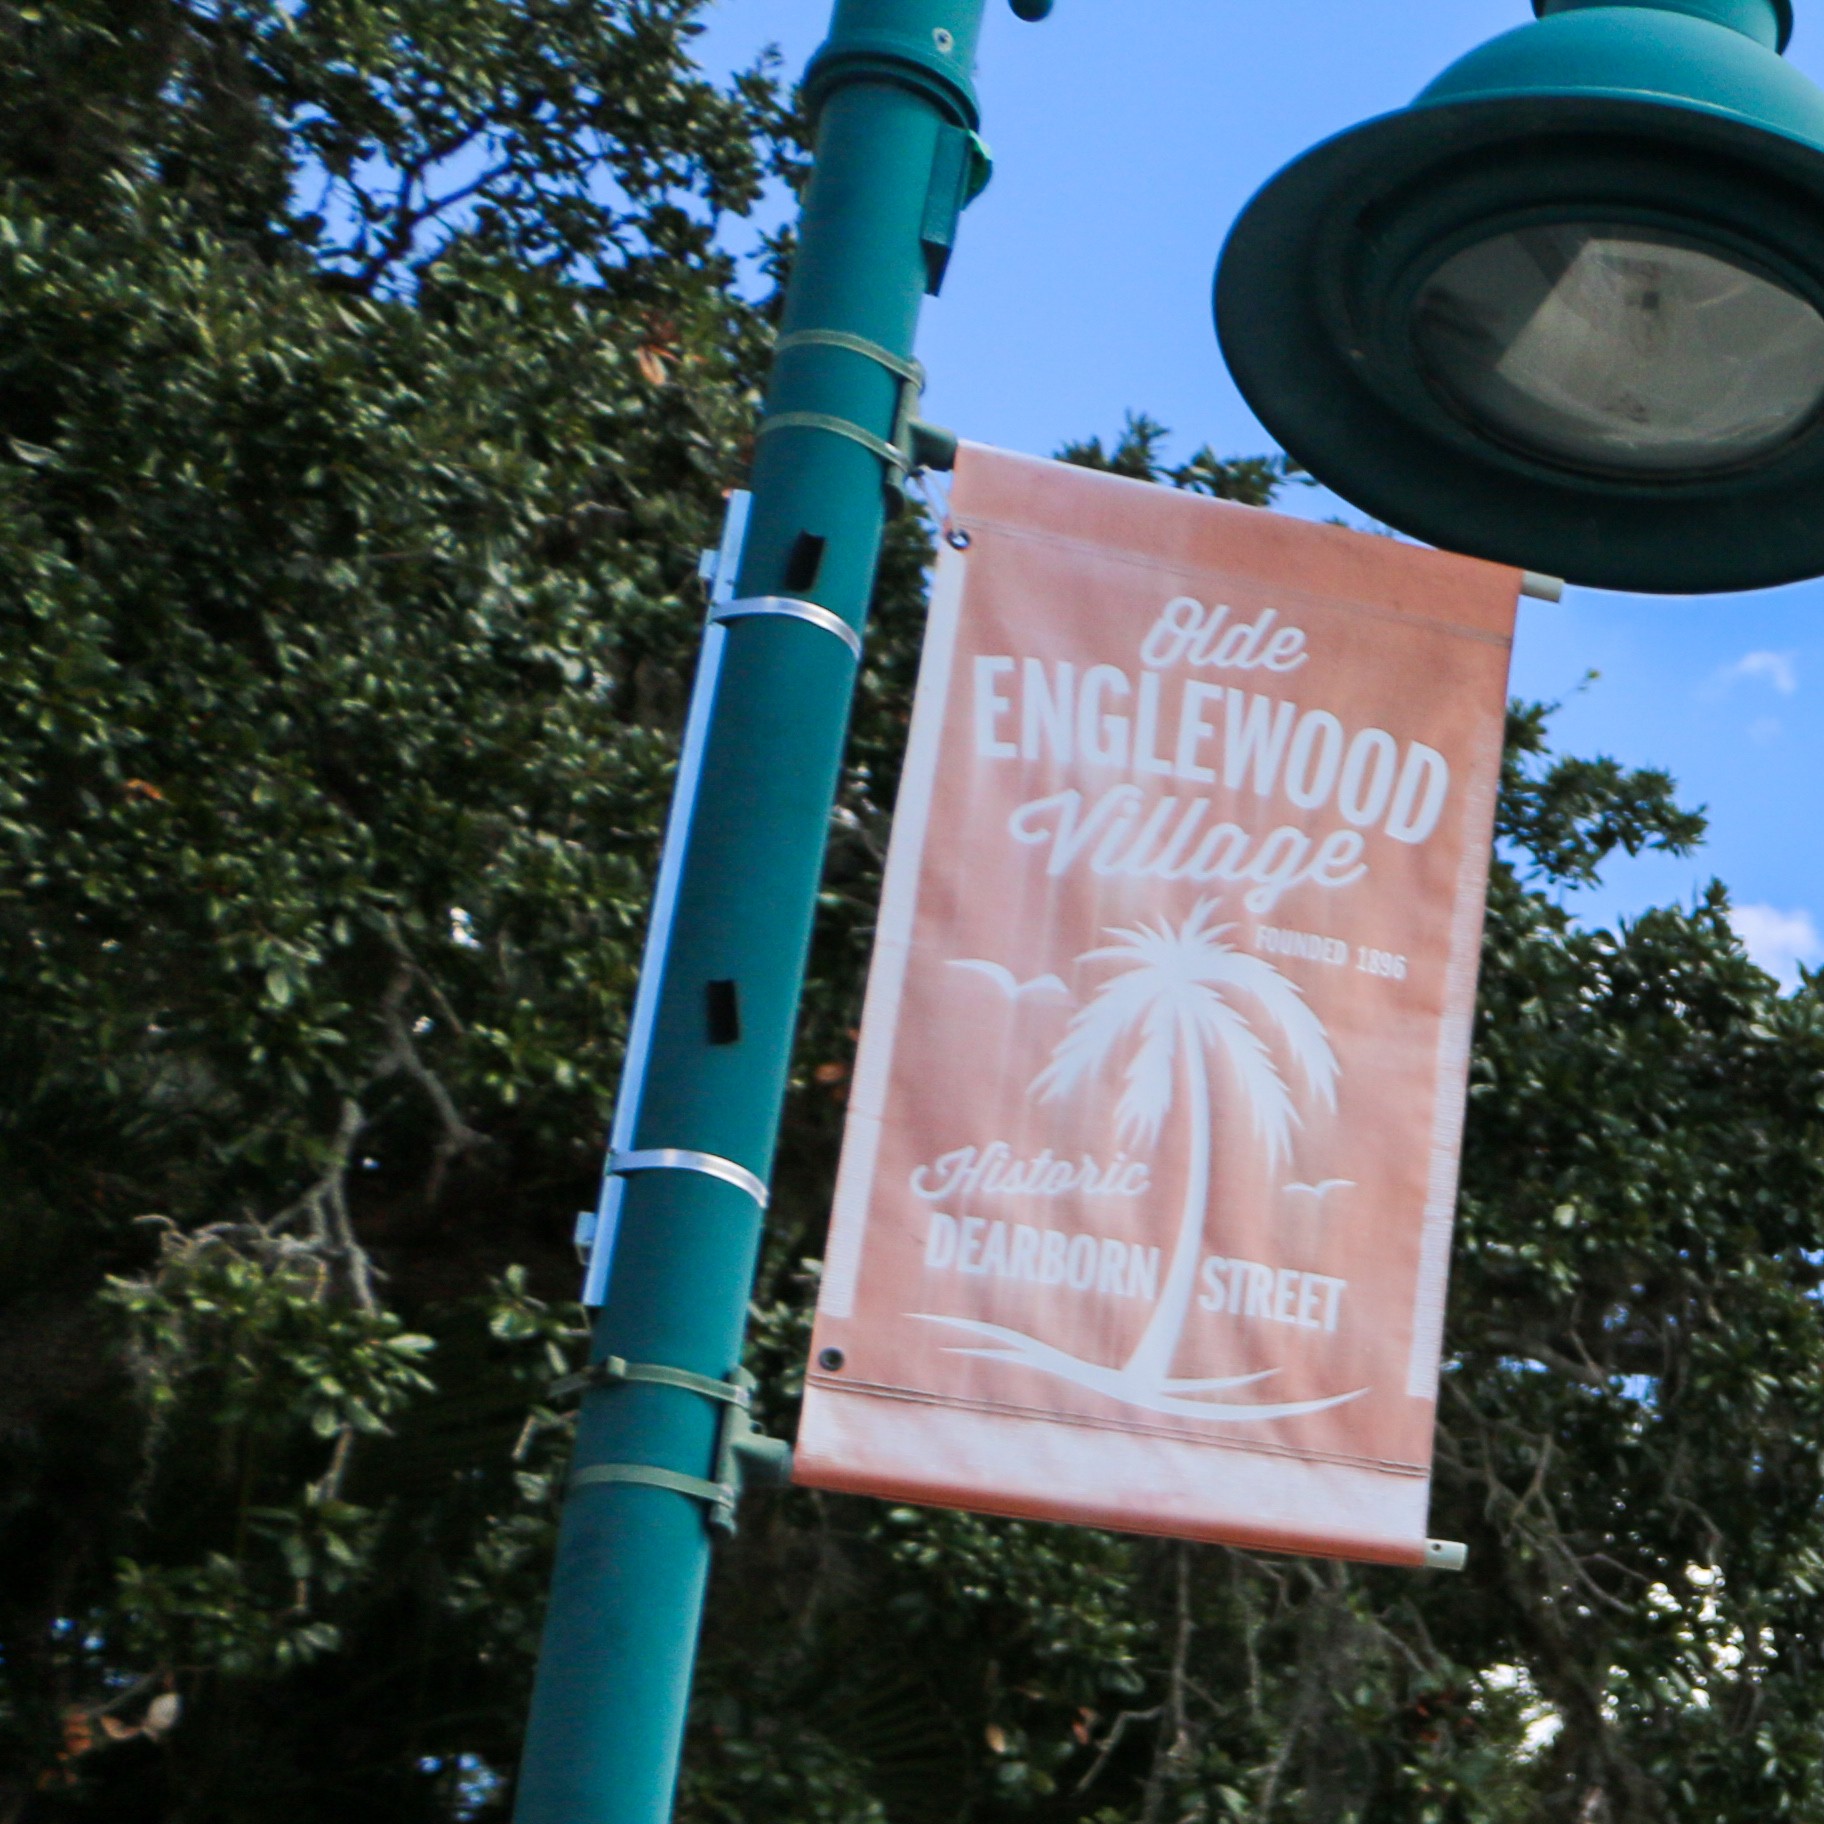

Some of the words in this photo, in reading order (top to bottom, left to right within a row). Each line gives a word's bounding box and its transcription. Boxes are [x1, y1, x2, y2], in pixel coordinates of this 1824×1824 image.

[1141, 596, 1308, 671] Olde
[973, 654, 1448, 844] ENGLEWOOD
[1008, 784, 1369, 913] Village
[1256, 926, 1348, 966] FOUNDED
[1356, 945, 1407, 981] 1896
[910, 1141, 1151, 1200] Historic
[925, 1213, 1159, 1301] DEARBORN
[1200, 1256, 1346, 1333] STREET
